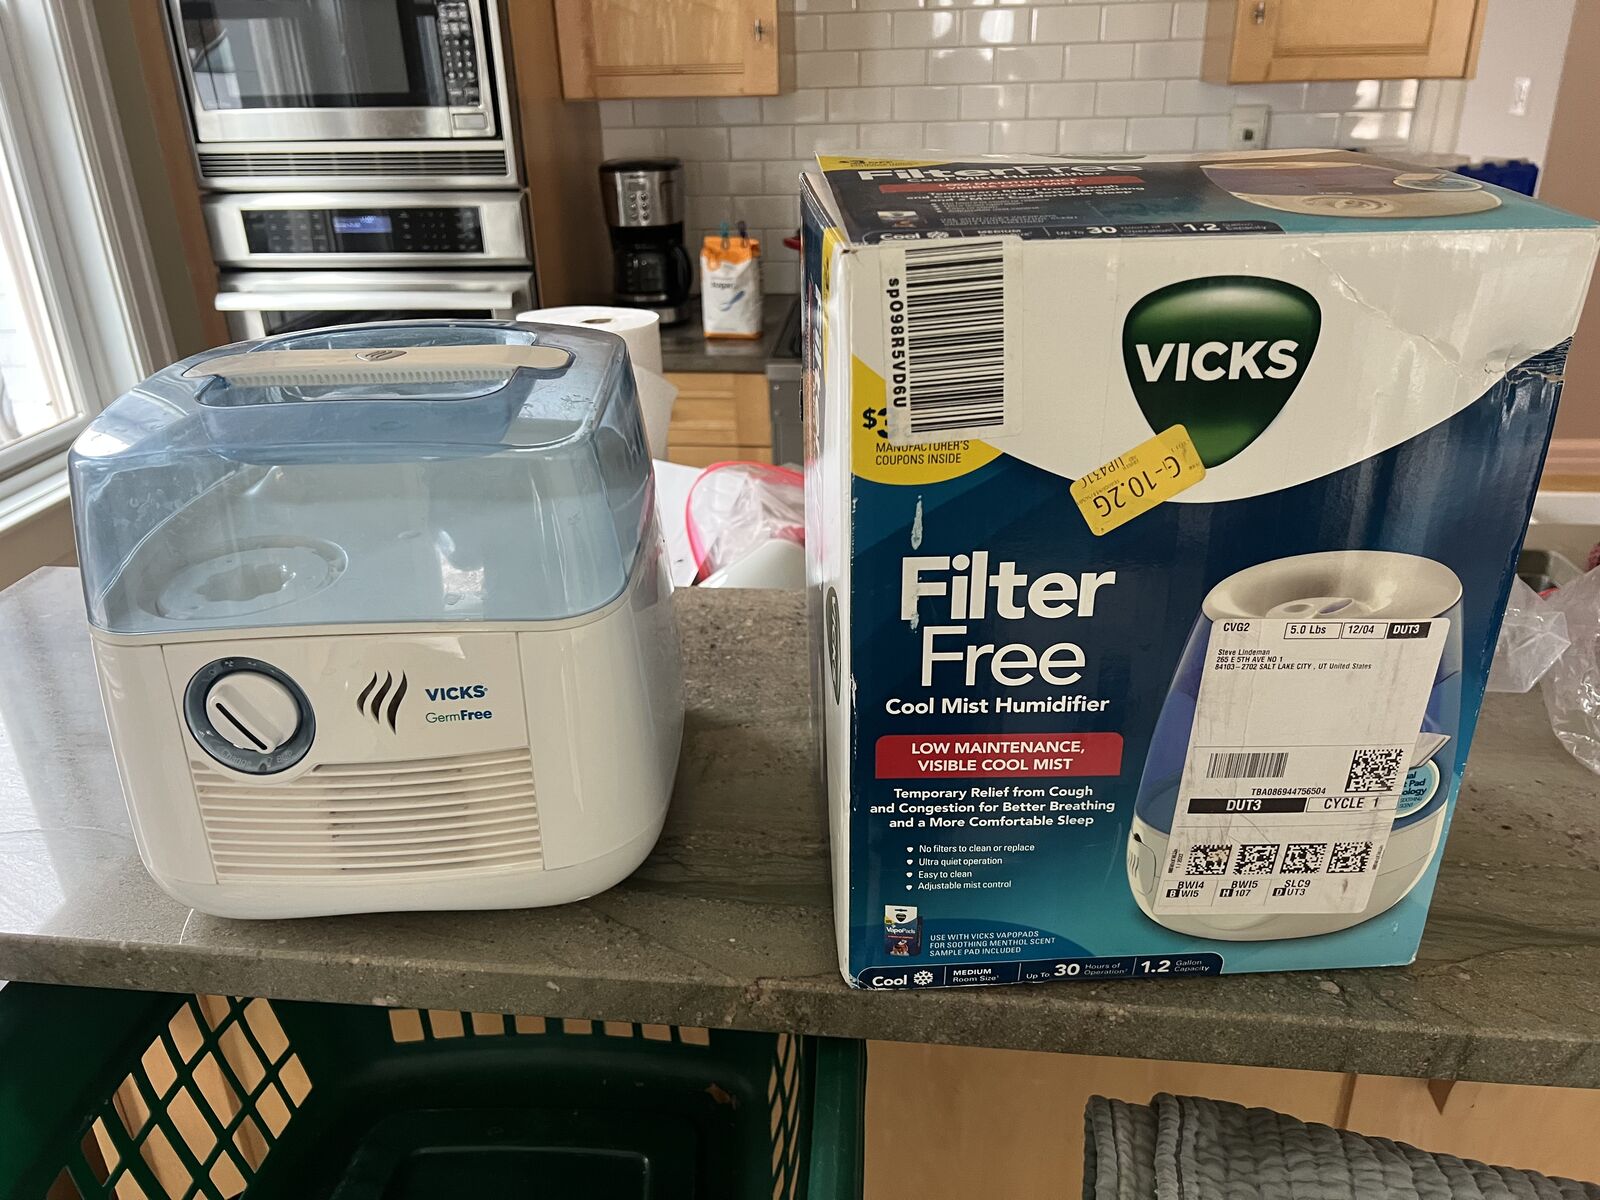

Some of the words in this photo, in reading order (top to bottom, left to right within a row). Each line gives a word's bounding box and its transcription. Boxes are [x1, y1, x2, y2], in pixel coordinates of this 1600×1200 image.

[1086, 226, 1117, 234] 30
[1183, 223, 1220, 231] 1.2
[1135, 340, 1299, 382] VICKS
[876, 454, 925, 465] COUPONS
[928, 453, 961, 464] INSIDE
[901, 551, 1116, 620] Filter
[1223, 622, 1250, 633] CVG2
[1290, 625, 1306, 634] 5.0
[1309, 624, 1327, 634] Lbs
[1348, 624, 1375, 634] 12/04
[1392, 624, 1420, 634] DUT3
[921, 625, 1086, 686] Free
[885, 697, 933, 715] Cool
[942, 697, 989, 714] Mist
[995, 695, 1110, 713] Humidifier
[425, 709, 493, 724] GermFree
[911, 742, 950, 755] LOW
[955, 741, 1085, 754] MAINTENANCE,
[918, 759, 976, 772] VISIBLE
[982, 759, 1028, 771] COOL
[1033, 758, 1073, 770] MIST
[894, 788, 967, 801] Temporary
[971, 787, 1011, 798] Relief
[1012, 786, 1045, 797] from
[1049, 786, 1093, 798] Cough
[870, 802, 895, 813] and
[898, 801, 975, 815] Congestion
[979, 801, 999, 812] for
[1002, 801, 1046, 811] Better
[1050, 800, 1115, 813] Breathing
[1226, 799, 1262, 811] DUT3
[1324, 798, 1364, 809] CYCLE
[1372, 798, 1378, 808] 1
[889, 817, 914, 828] and
[918, 819, 926, 827] a
[930, 817, 965, 827] More
[969, 816, 1054, 827] Comfortable
[1057, 815, 1094, 827] Sleep
[919, 844, 930, 852] No
[933, 844, 957, 852] filters
[968, 844, 992, 852] clean
[1003, 844, 1035, 853] replace
[919, 858, 939, 866] Ultra
[940, 858, 961, 867] quiet
[963, 857, 1003, 867] operation
[918, 871, 938, 880] Easy
[950, 870, 972, 878] clean
[918, 882, 961, 891] Adjustable
[963, 881, 981, 889] mist
[1177, 881, 1205, 889] BWI4
[1231, 880, 1258, 888] BWI5
[1284, 880, 1311, 888] SLC9
[996, 931, 1039, 939] VAPOPADS
[947, 940, 988, 948] SOOTHING
[989, 939, 1029, 947] MENTHOL
[1030, 937, 1056, 945] SCENT
[930, 949, 962, 957] SAMPLE
[964, 948, 981, 956] PAD
[982, 947, 1021, 955] INCLUDED
[1054, 963, 1080, 977] 30
[1141, 959, 1171, 973] 1.2
[872, 975, 907, 987] Cool
